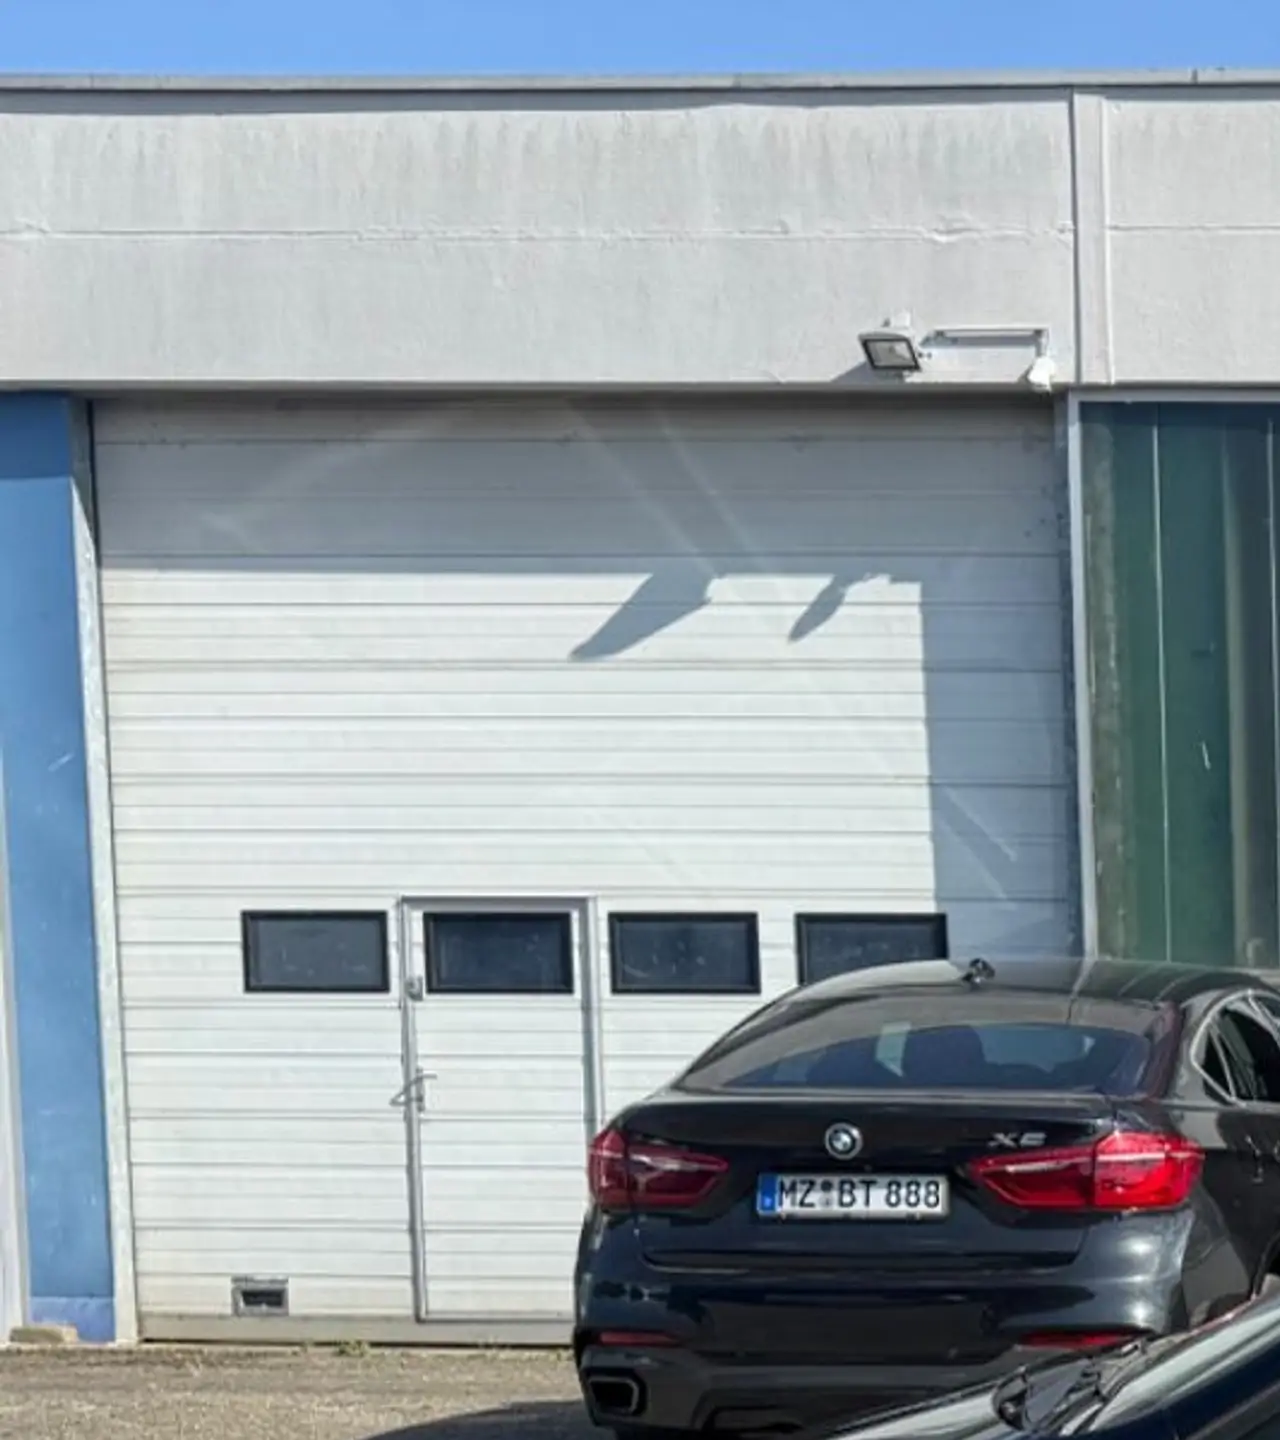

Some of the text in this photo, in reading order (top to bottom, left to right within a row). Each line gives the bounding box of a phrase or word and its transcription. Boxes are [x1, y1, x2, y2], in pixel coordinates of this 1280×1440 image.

[779, 1179, 941, 1208] MZ BT 888
